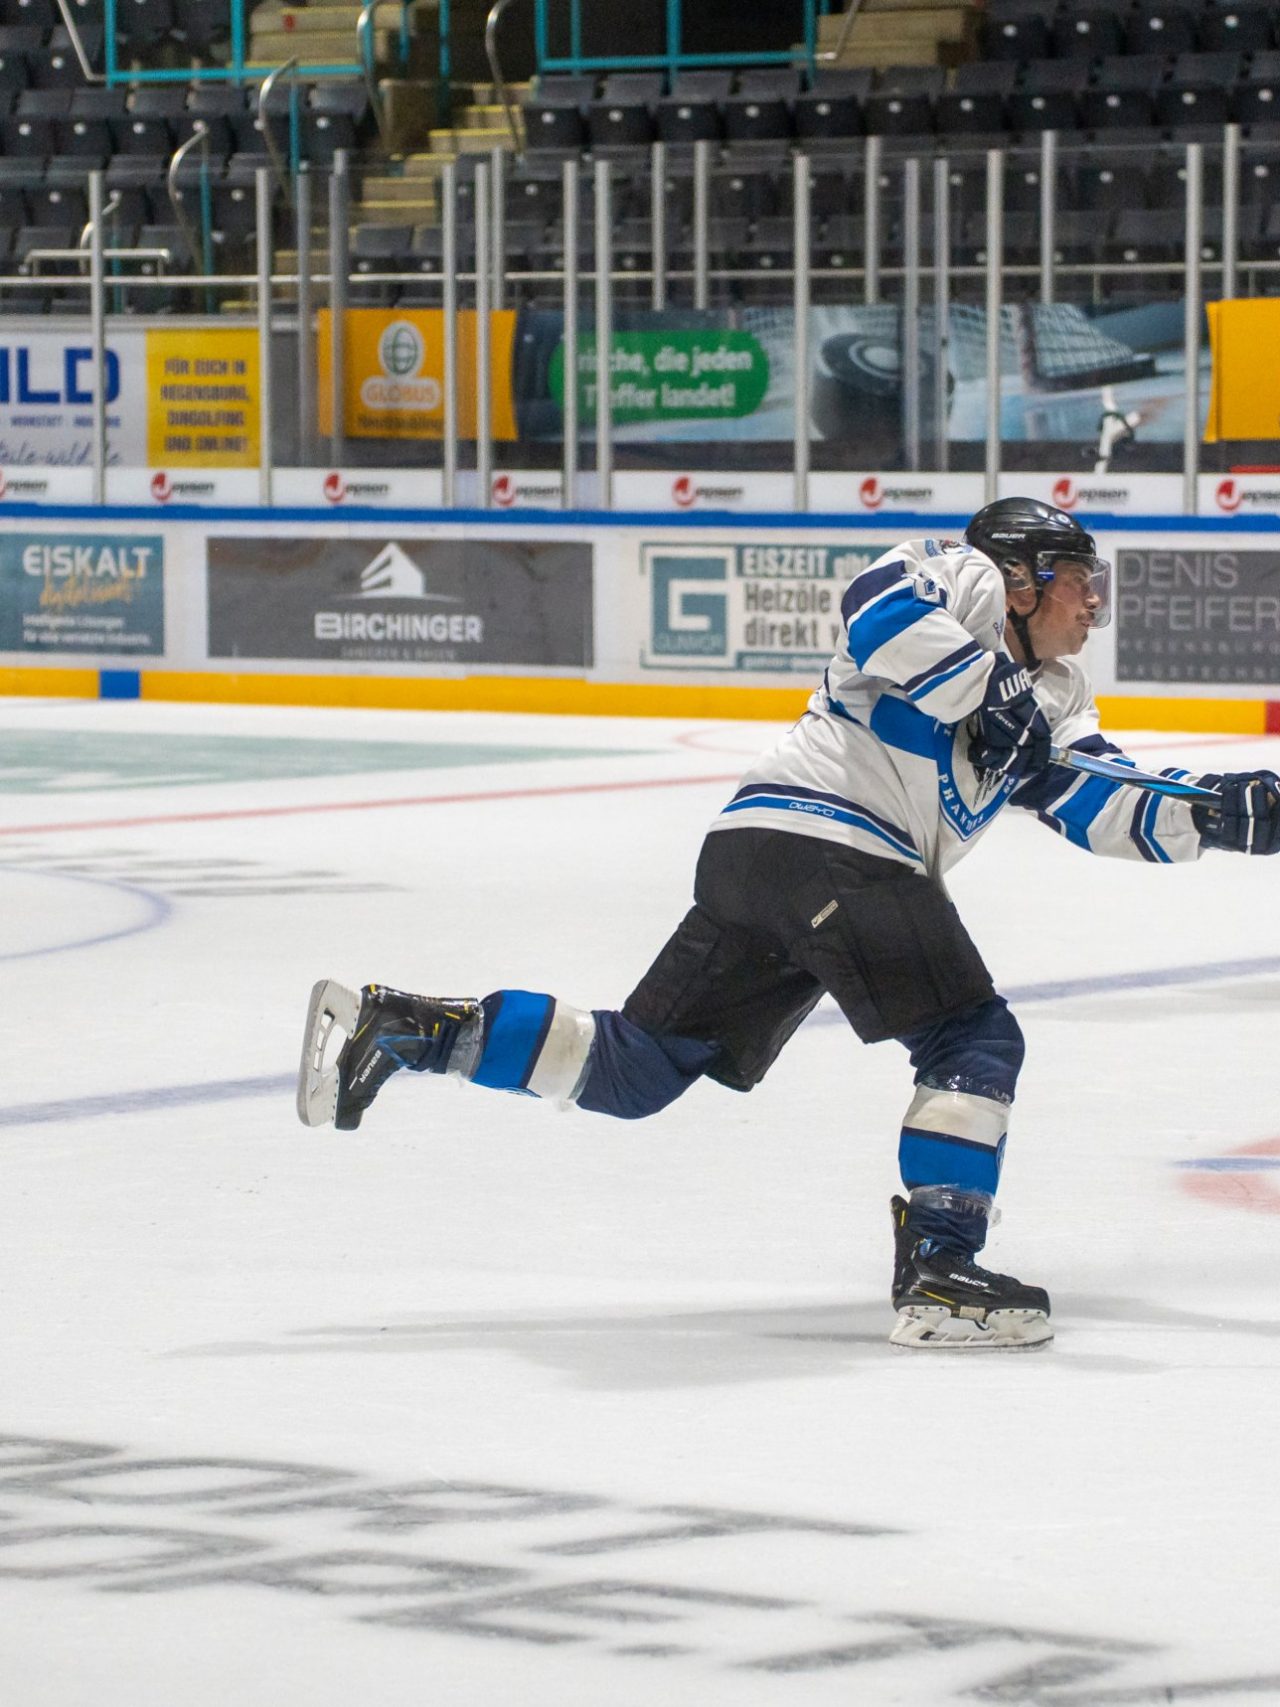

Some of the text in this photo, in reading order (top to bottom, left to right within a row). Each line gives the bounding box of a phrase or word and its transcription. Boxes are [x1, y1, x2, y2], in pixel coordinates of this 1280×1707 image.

[991, 532, 1026, 540] BAUER
[22, 543, 153, 578] EISKALT
[742, 549, 829, 577] EISZEIT
[1120, 553, 1240, 589] DENIS
[743, 583, 832, 613] Heizöle
[1119, 594, 1280, 632] PFEIFER
[314, 611, 484, 643] BIRCHINGER
[743, 617, 819, 648] direkt
